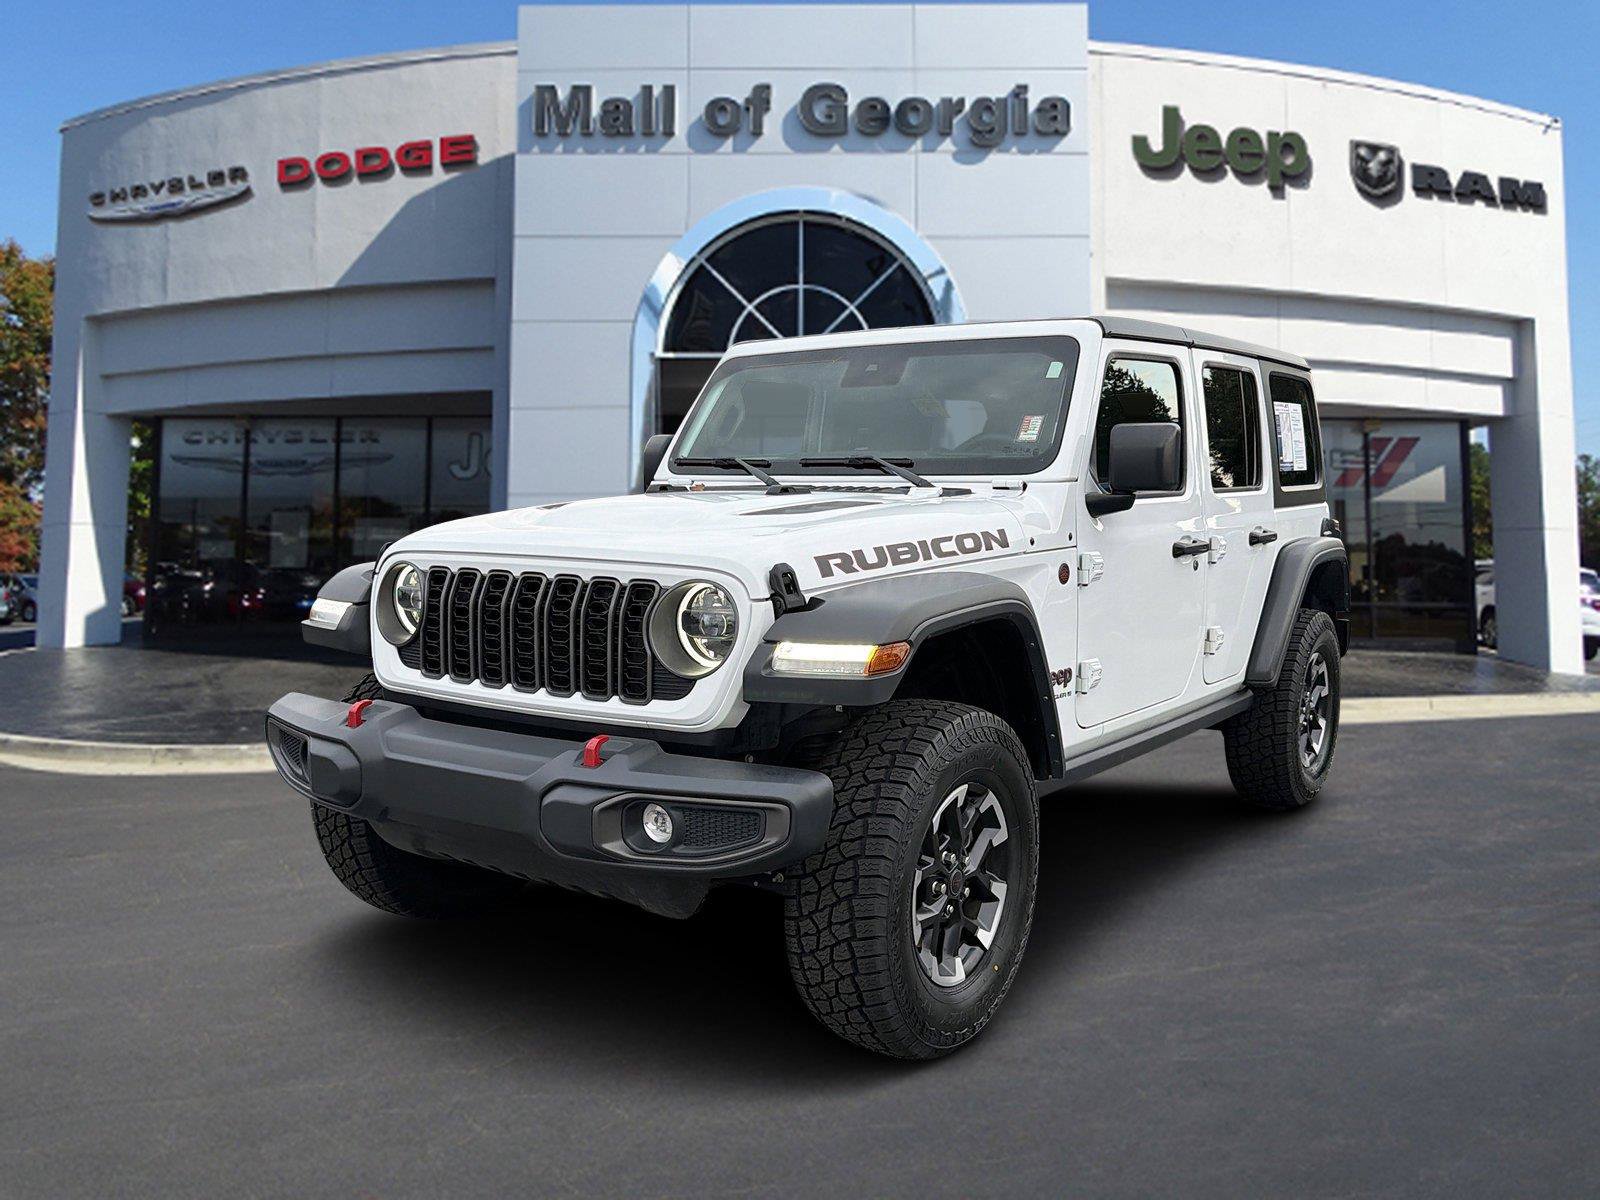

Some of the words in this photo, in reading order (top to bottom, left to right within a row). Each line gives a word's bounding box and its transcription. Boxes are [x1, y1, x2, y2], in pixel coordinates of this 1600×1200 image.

[532, 84, 676, 138] Mall
[703, 83, 772, 137] of
[799, 82, 1073, 148] Georgia
[276, 134, 478, 188] DODGE
[1131, 104, 1310, 196] Jeep
[89, 166, 249, 206] CHRYSLER
[1411, 163, 1548, 212] RAM
[182, 429, 381, 445] CHRYSLER
[813, 528, 1010, 579] RUBICON
[1050, 667, 1073, 689] eep
